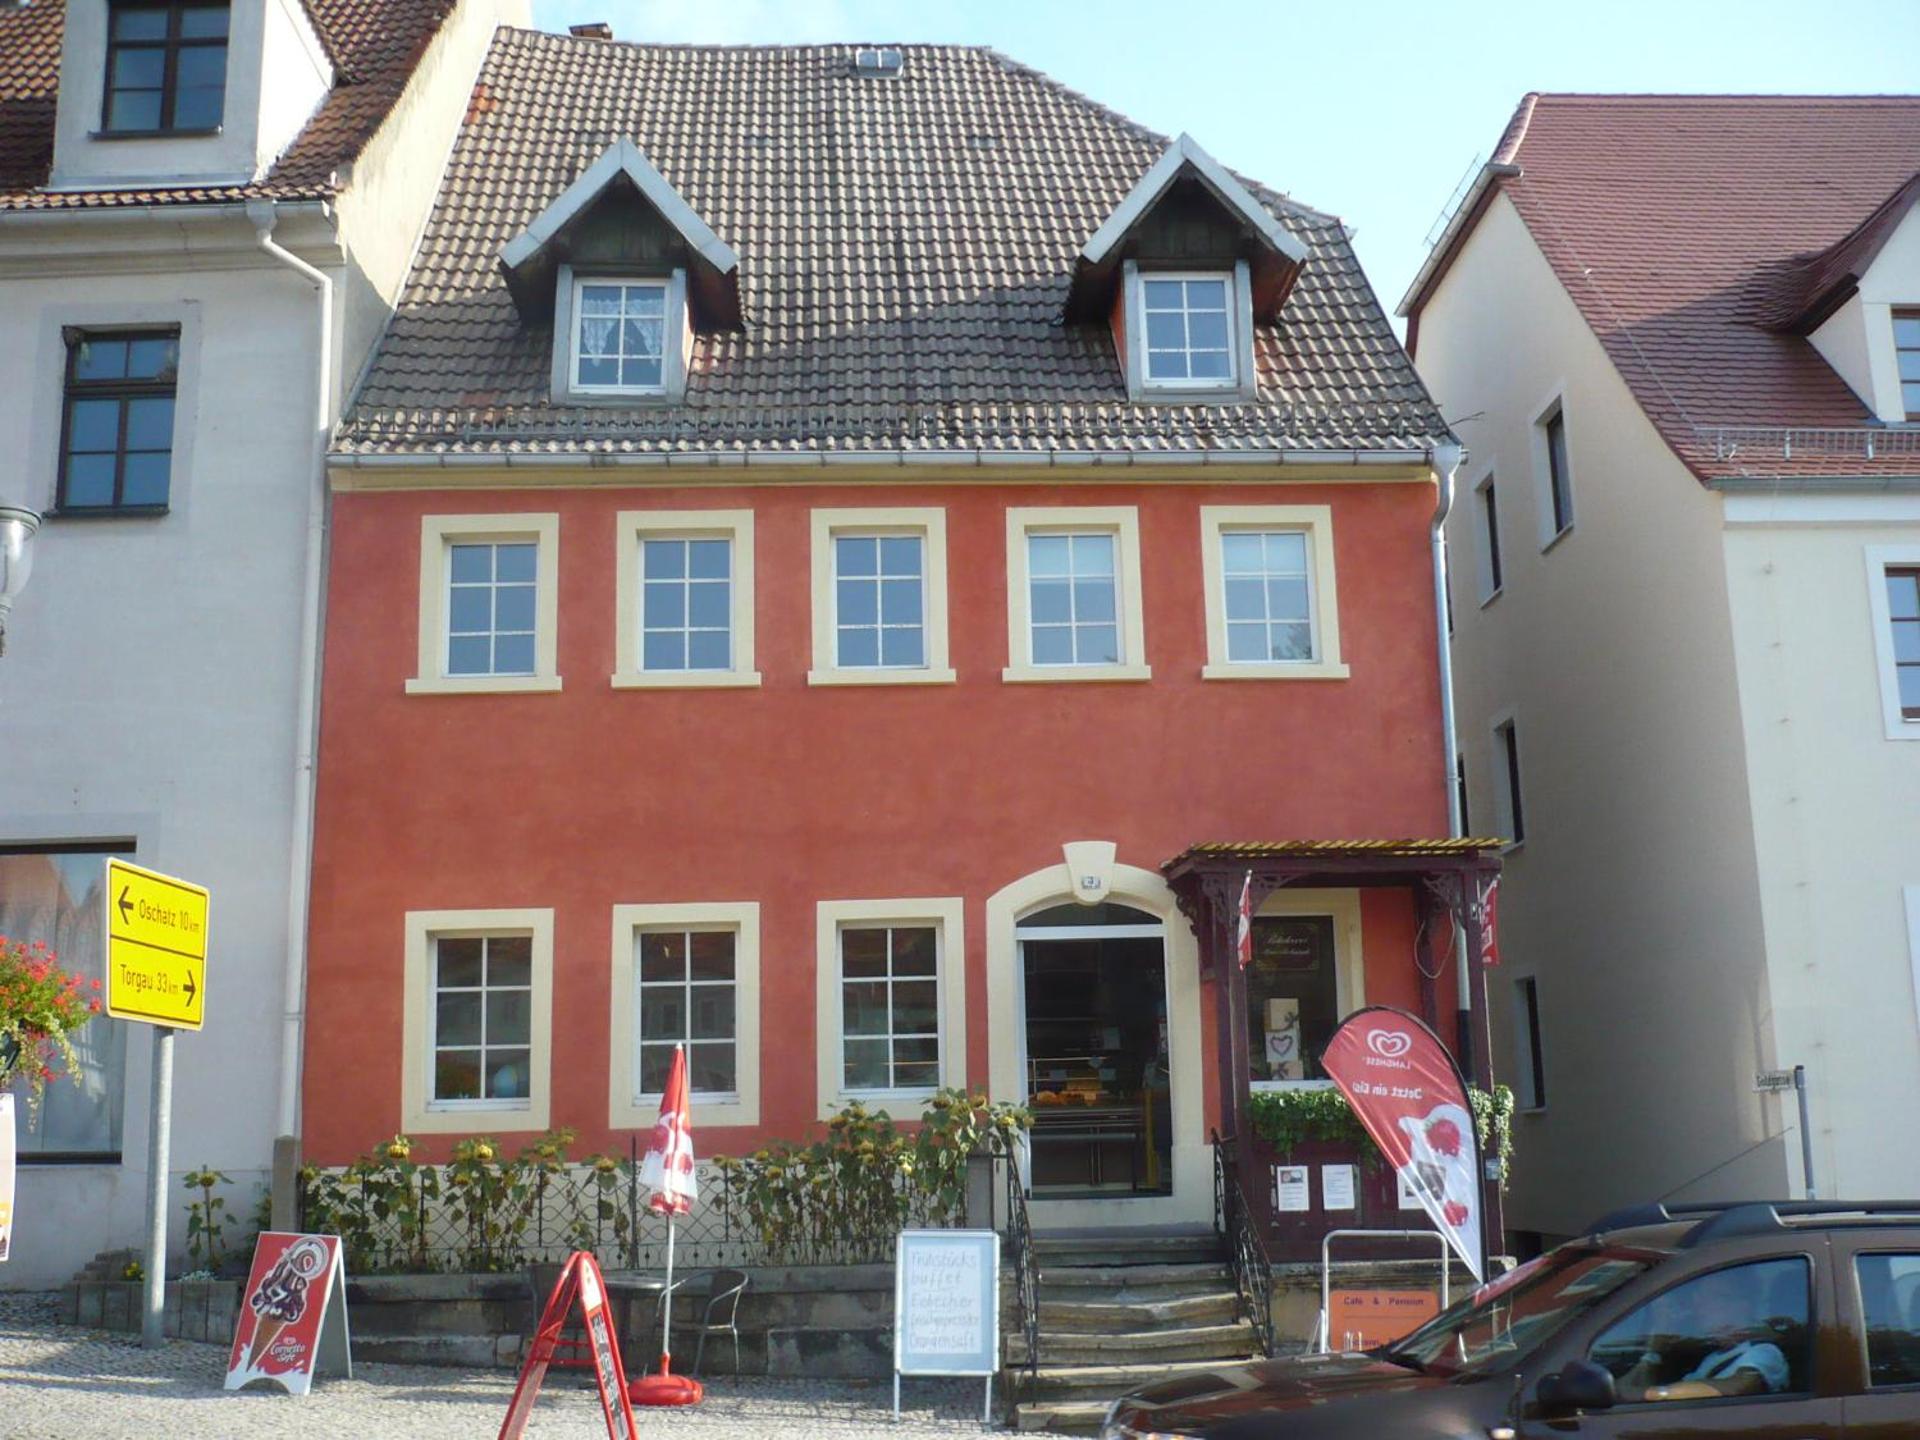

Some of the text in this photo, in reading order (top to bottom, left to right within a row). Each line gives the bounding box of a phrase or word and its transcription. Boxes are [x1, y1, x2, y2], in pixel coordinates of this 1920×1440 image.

[139, 899, 199, 932] Oschatz 10 km
[120, 963, 178, 994] Torgau 33 km
[1374, 1297, 1380, 1305] &
[1388, 1297, 1424, 1306] Pension
